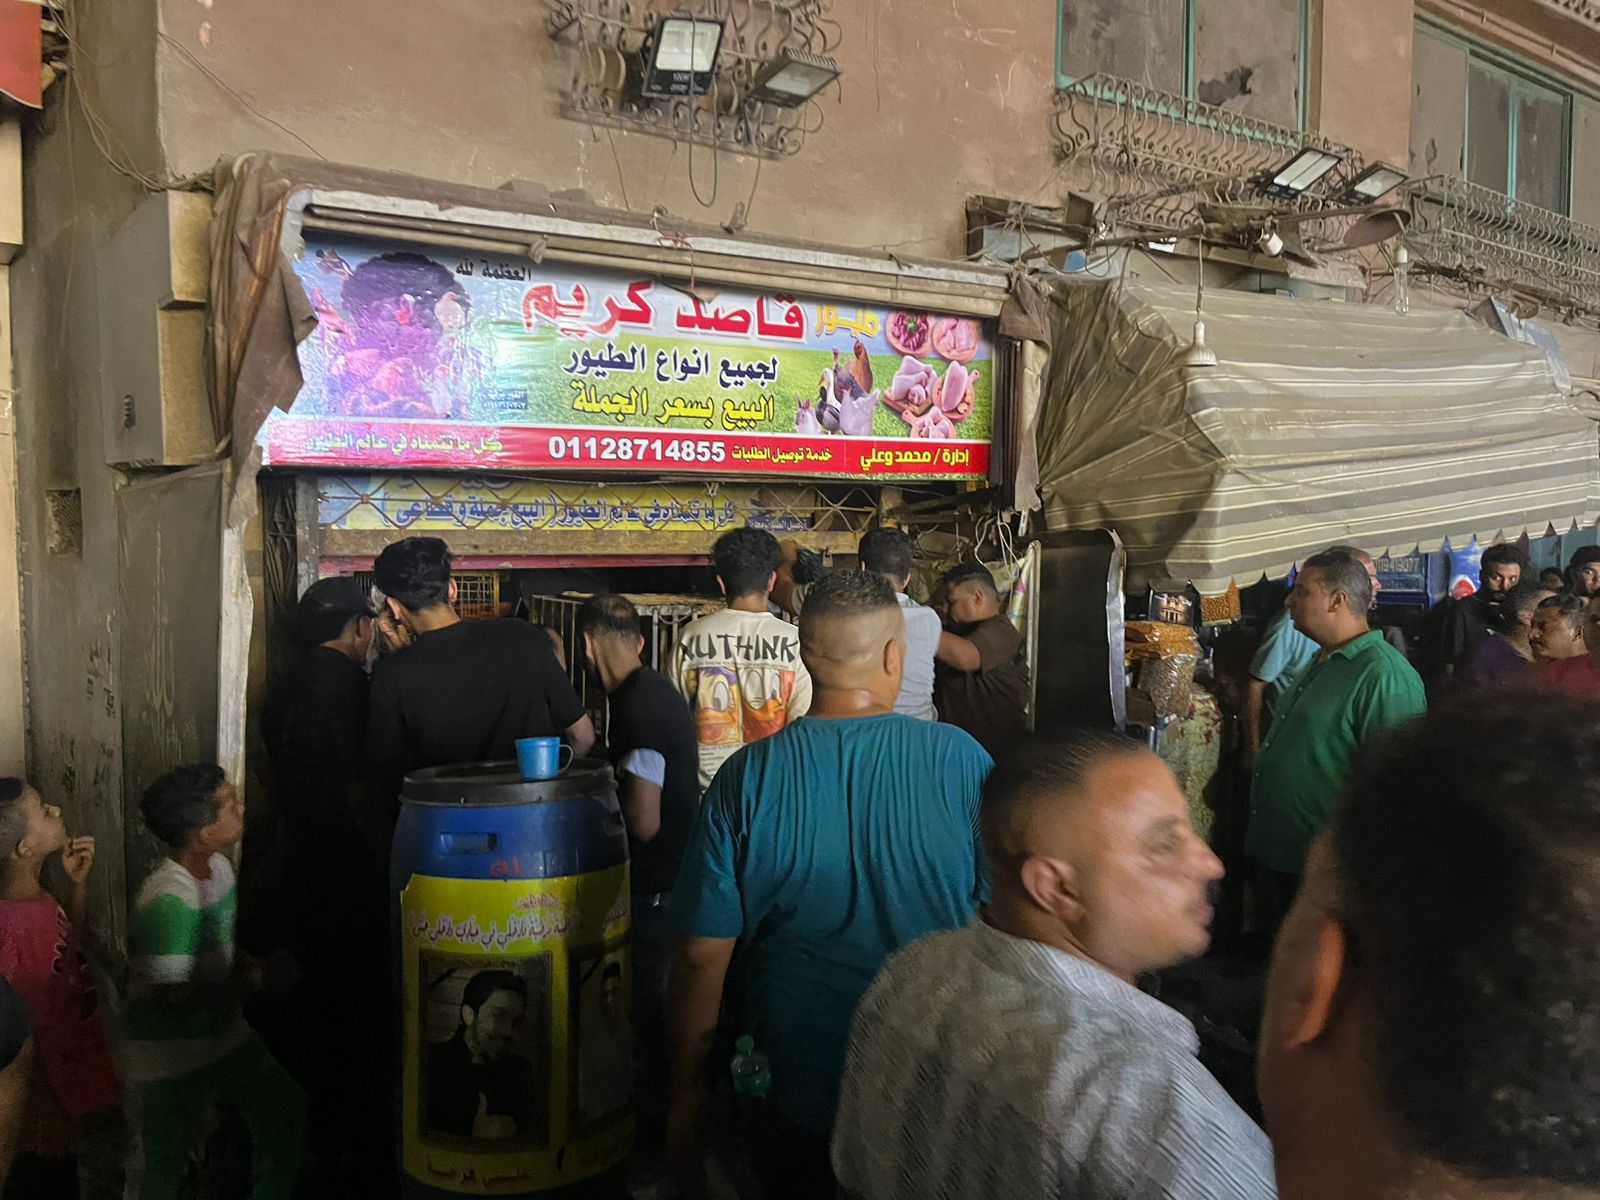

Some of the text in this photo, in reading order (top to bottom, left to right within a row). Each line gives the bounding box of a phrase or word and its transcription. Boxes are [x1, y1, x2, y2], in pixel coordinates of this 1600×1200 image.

[455, 257, 532, 282] العظمة لله
[522, 279, 654, 338] كريم
[676, 291, 806, 342] قاصد
[563, 341, 778, 390] لجميع انواع الطيور
[571, 380, 649, 425] الجملة
[655, 394, 715, 429] بسعر
[721, 394, 775, 431] البيع
[304, 432, 353, 453] الطيور
[356, 431, 388, 456] عالم
[457, 433, 471, 452] ما
[471, 429, 503, 455] كل
[548, 435, 727, 464] 01128714855
[731, 444, 833, 464] خدمة توصيل الطلبات
[941, 448, 970, 466] إدارة
[704, 501, 715, 523] ما
[718, 500, 738, 526] كل
